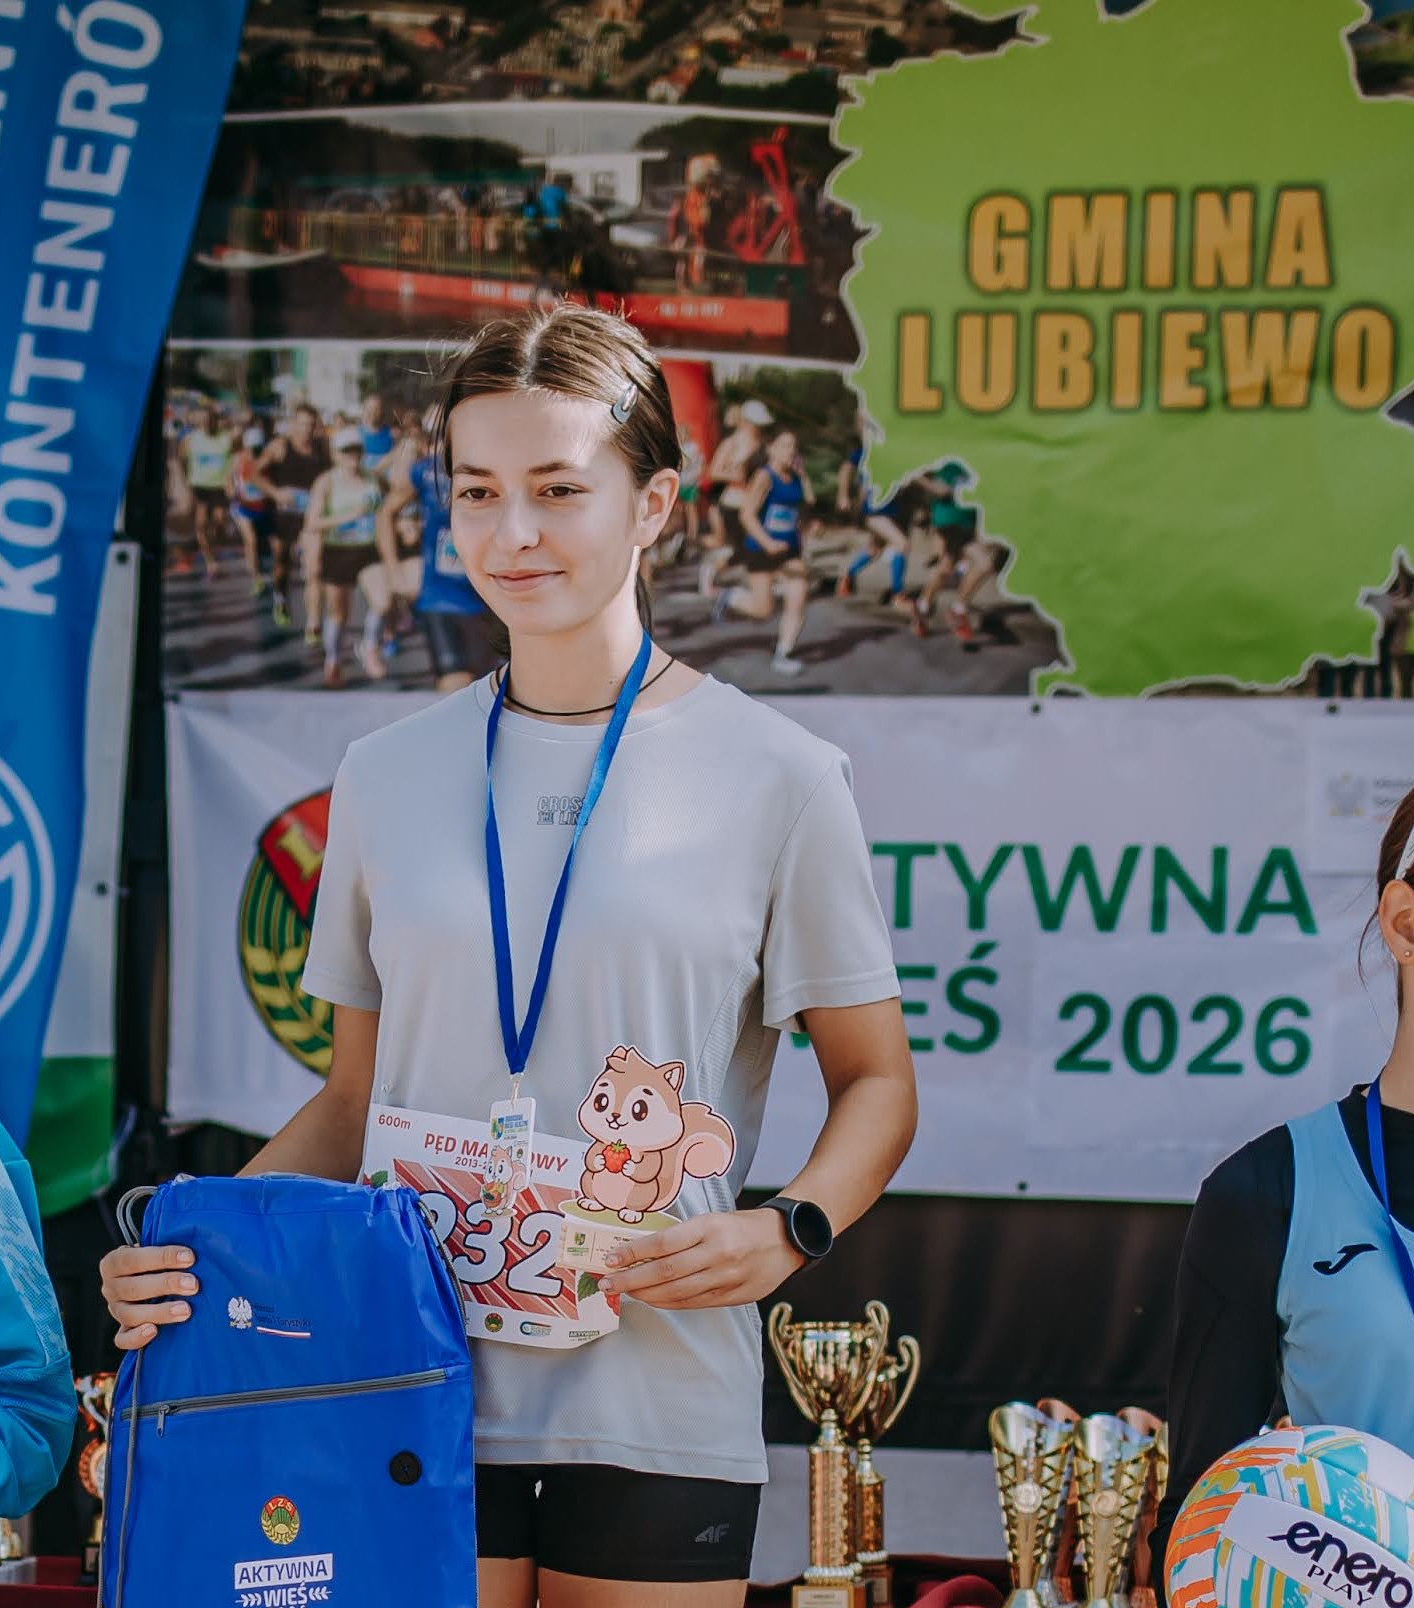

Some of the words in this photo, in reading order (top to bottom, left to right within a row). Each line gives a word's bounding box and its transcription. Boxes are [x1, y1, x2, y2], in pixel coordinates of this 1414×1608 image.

[965, 188, 1332, 292] GMINA
[895, 308, 1399, 414] LUBIEWO
[558, 811, 588, 826] LIN
[1055, 992, 1313, 1077] 2026
[377, 1113, 412, 1131] 600m
[424, 1132, 458, 1156] PĘD
[268, 1498, 294, 1512] LZS
[238, 1559, 328, 1585] AKTYWNA
[1307, 1564, 1372, 1606] PLAY
[263, 1580, 308, 1608] WIEŚ
